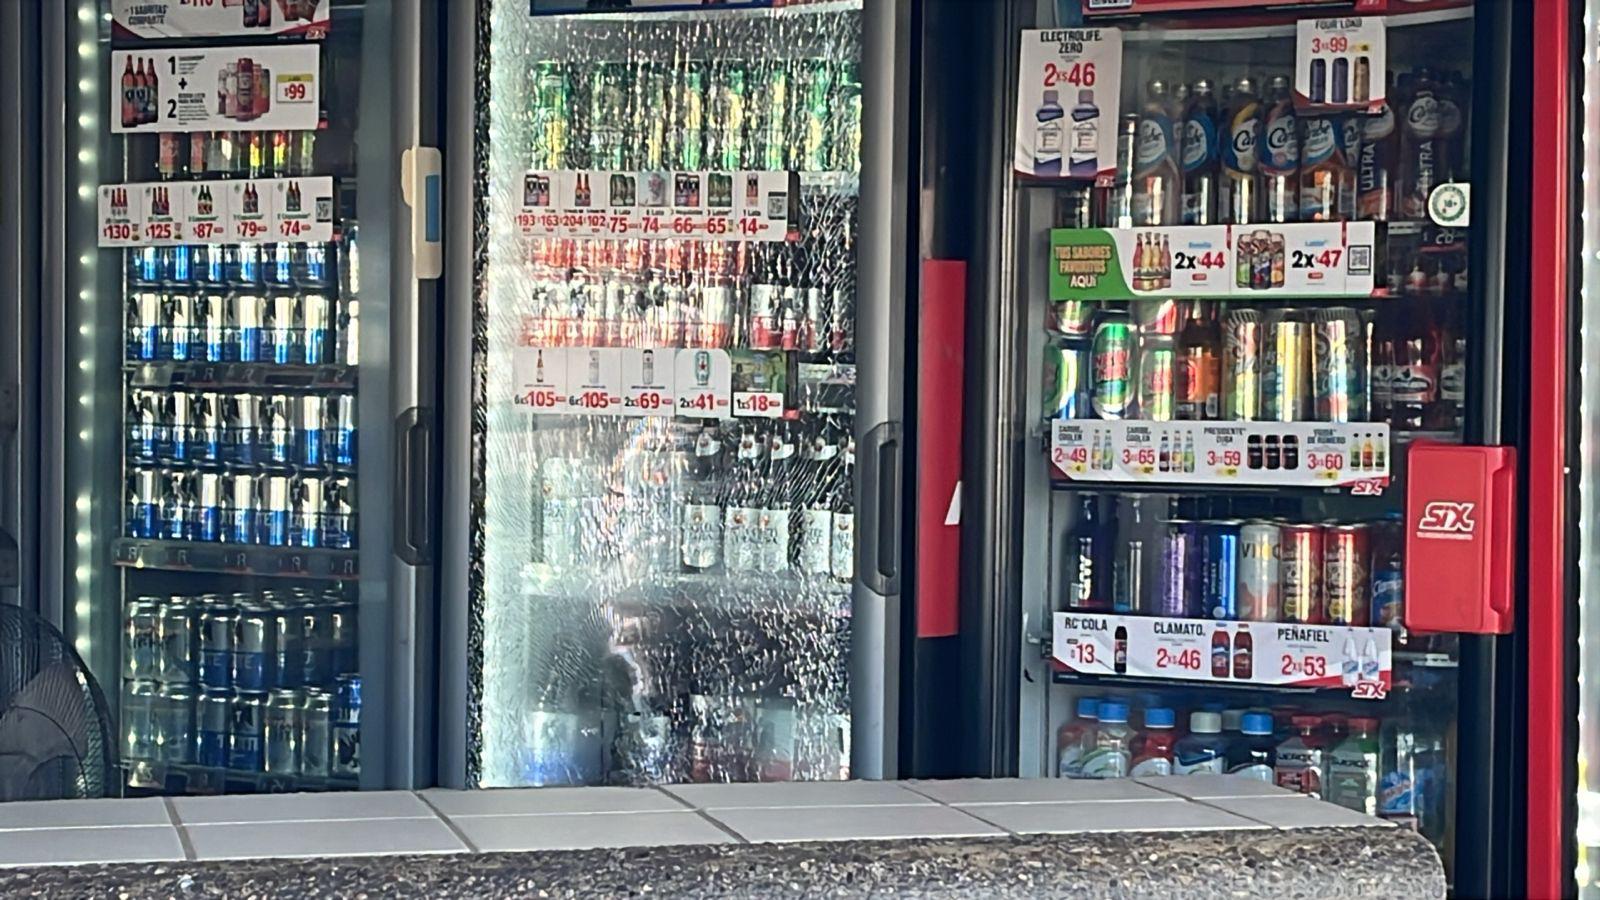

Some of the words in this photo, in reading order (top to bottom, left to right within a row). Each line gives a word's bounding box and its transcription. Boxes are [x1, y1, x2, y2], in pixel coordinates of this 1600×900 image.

[1058, 42, 1083, 54] ZERO
[167, 56, 176, 75] 1
[166, 98, 177, 119] 2
[1361, 142, 1376, 191] ULTRA
[1064, 616, 1078, 629] RC
[1081, 618, 1108, 632] COLA
[1277, 625, 1330, 643] PEÑAFIEL
